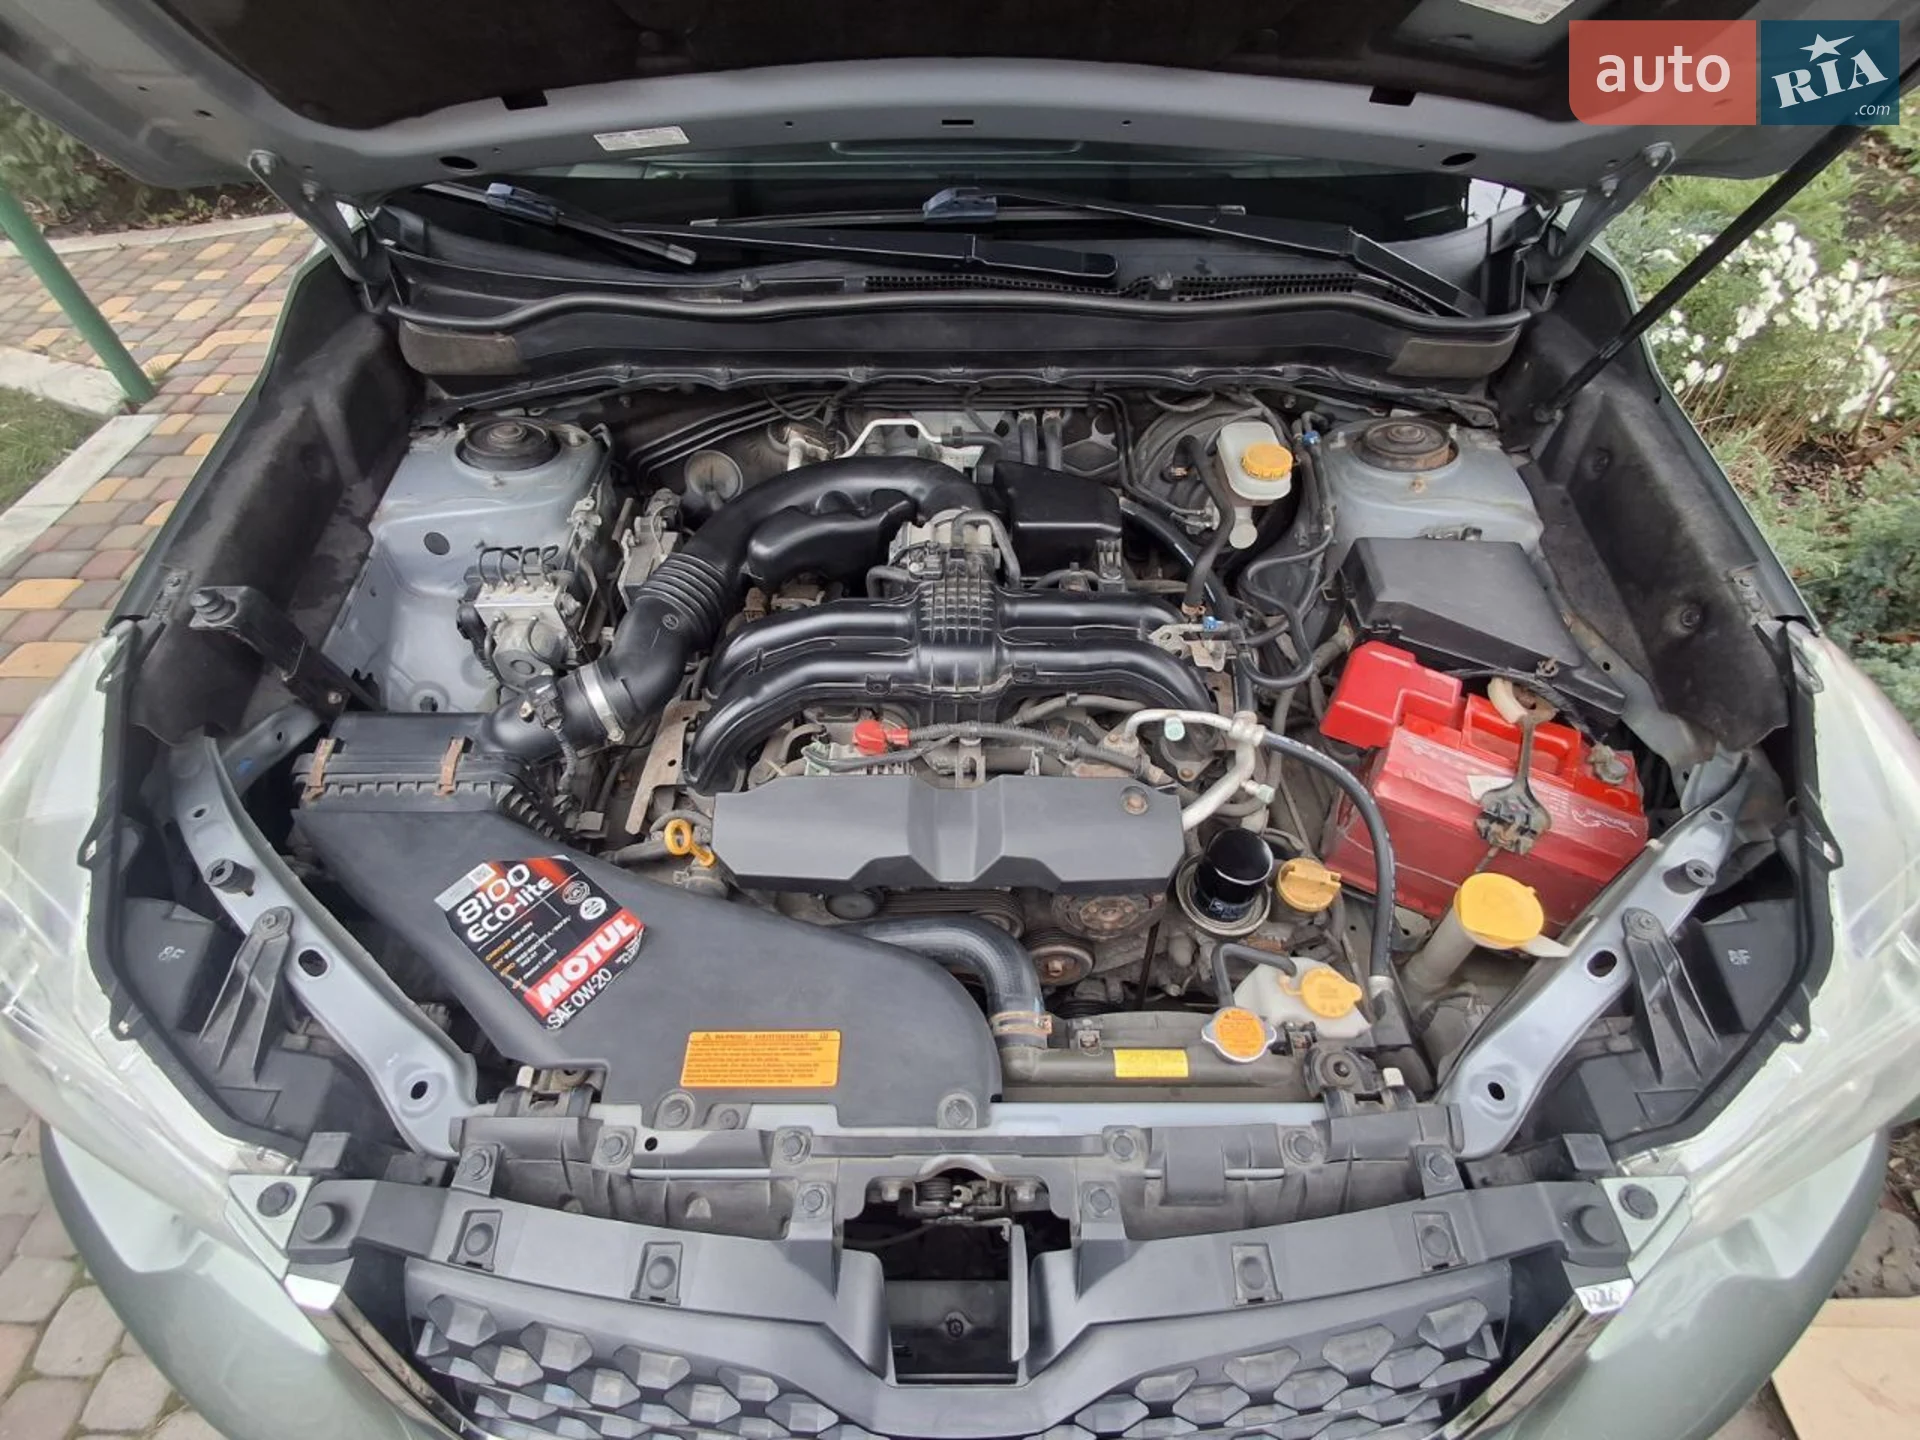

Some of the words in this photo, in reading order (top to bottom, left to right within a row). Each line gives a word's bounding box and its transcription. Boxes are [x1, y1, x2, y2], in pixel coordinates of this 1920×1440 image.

[457, 864, 530, 925] 8100
[537, 914, 635, 1009] MOTUL
[547, 1001, 576, 1029] SAE
[573, 968, 612, 1011] 0W-20
